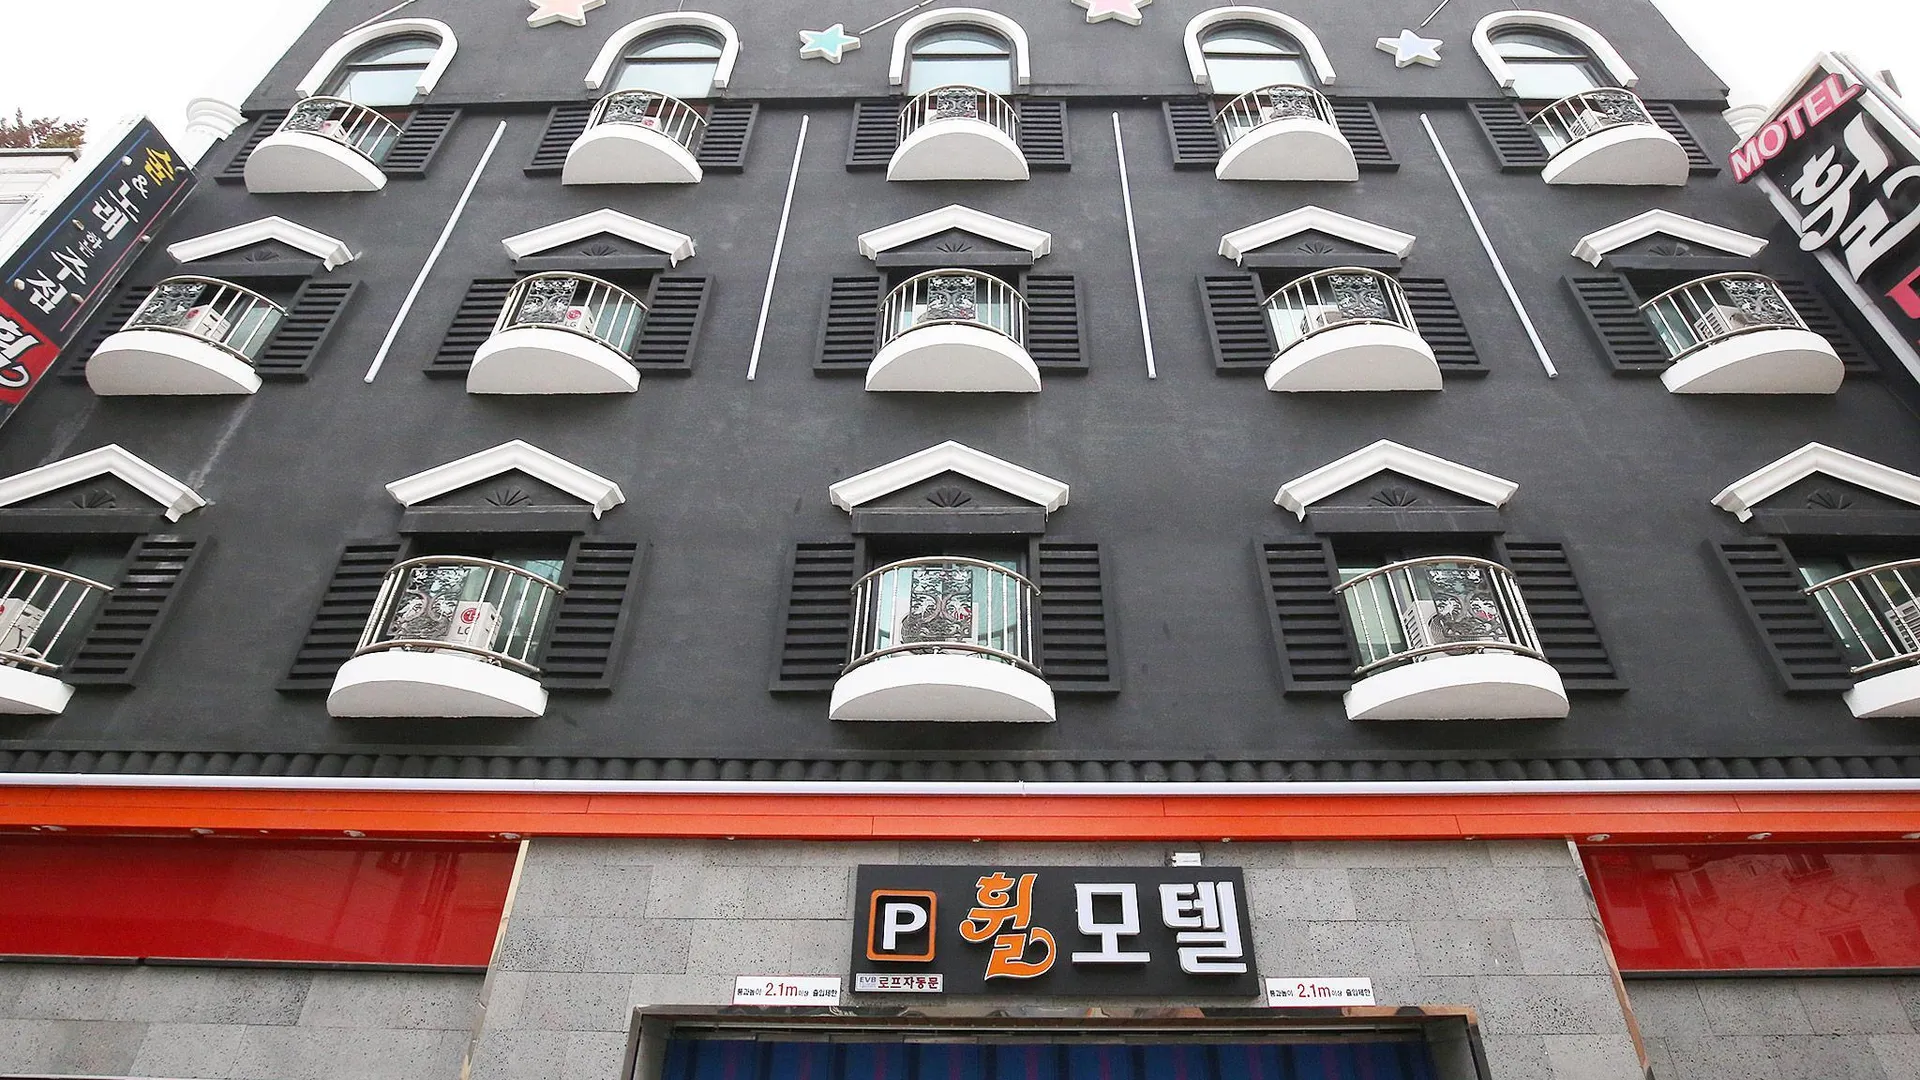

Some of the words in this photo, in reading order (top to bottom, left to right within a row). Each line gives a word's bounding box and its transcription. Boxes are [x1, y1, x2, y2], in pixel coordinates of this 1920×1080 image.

[1729, 73, 1861, 183] MOTEL
[131, 174, 149, 199] &
[144, 147, 174, 187] 술
[882, 902, 928, 951] P
[1071, 880, 1248, 975] 모텔
[878, 976, 939, 989] 로프자동문
